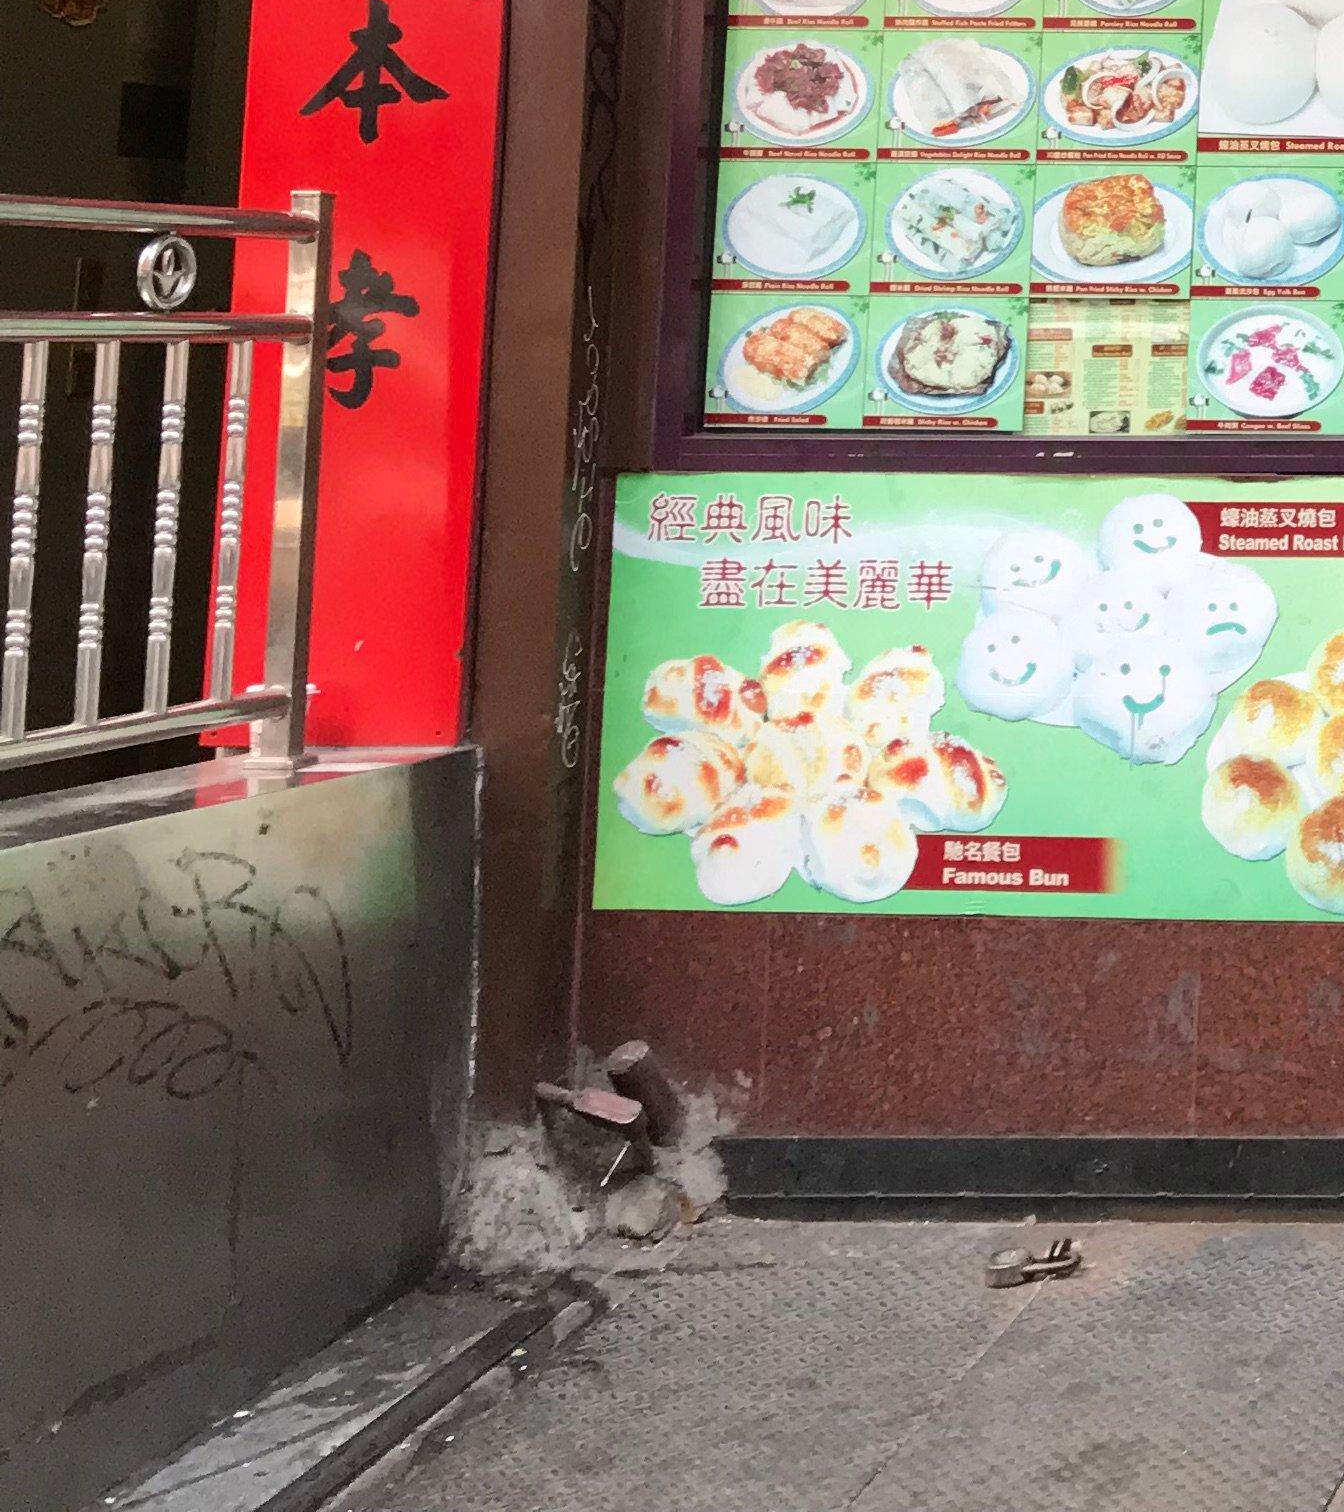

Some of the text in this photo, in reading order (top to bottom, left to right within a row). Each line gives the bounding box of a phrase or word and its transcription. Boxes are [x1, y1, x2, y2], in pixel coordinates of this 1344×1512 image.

[1286, 142, 1325, 150] Steamed
[647, 492, 853, 544] 經典風味
[1218, 533, 1288, 551] Steamed
[1293, 534, 1338, 551] Roast
[699, 558, 953, 610] 盡在美麗華
[943, 841, 1021, 862] 馳名餐包
[942, 867, 1069, 886] Famous Bun
